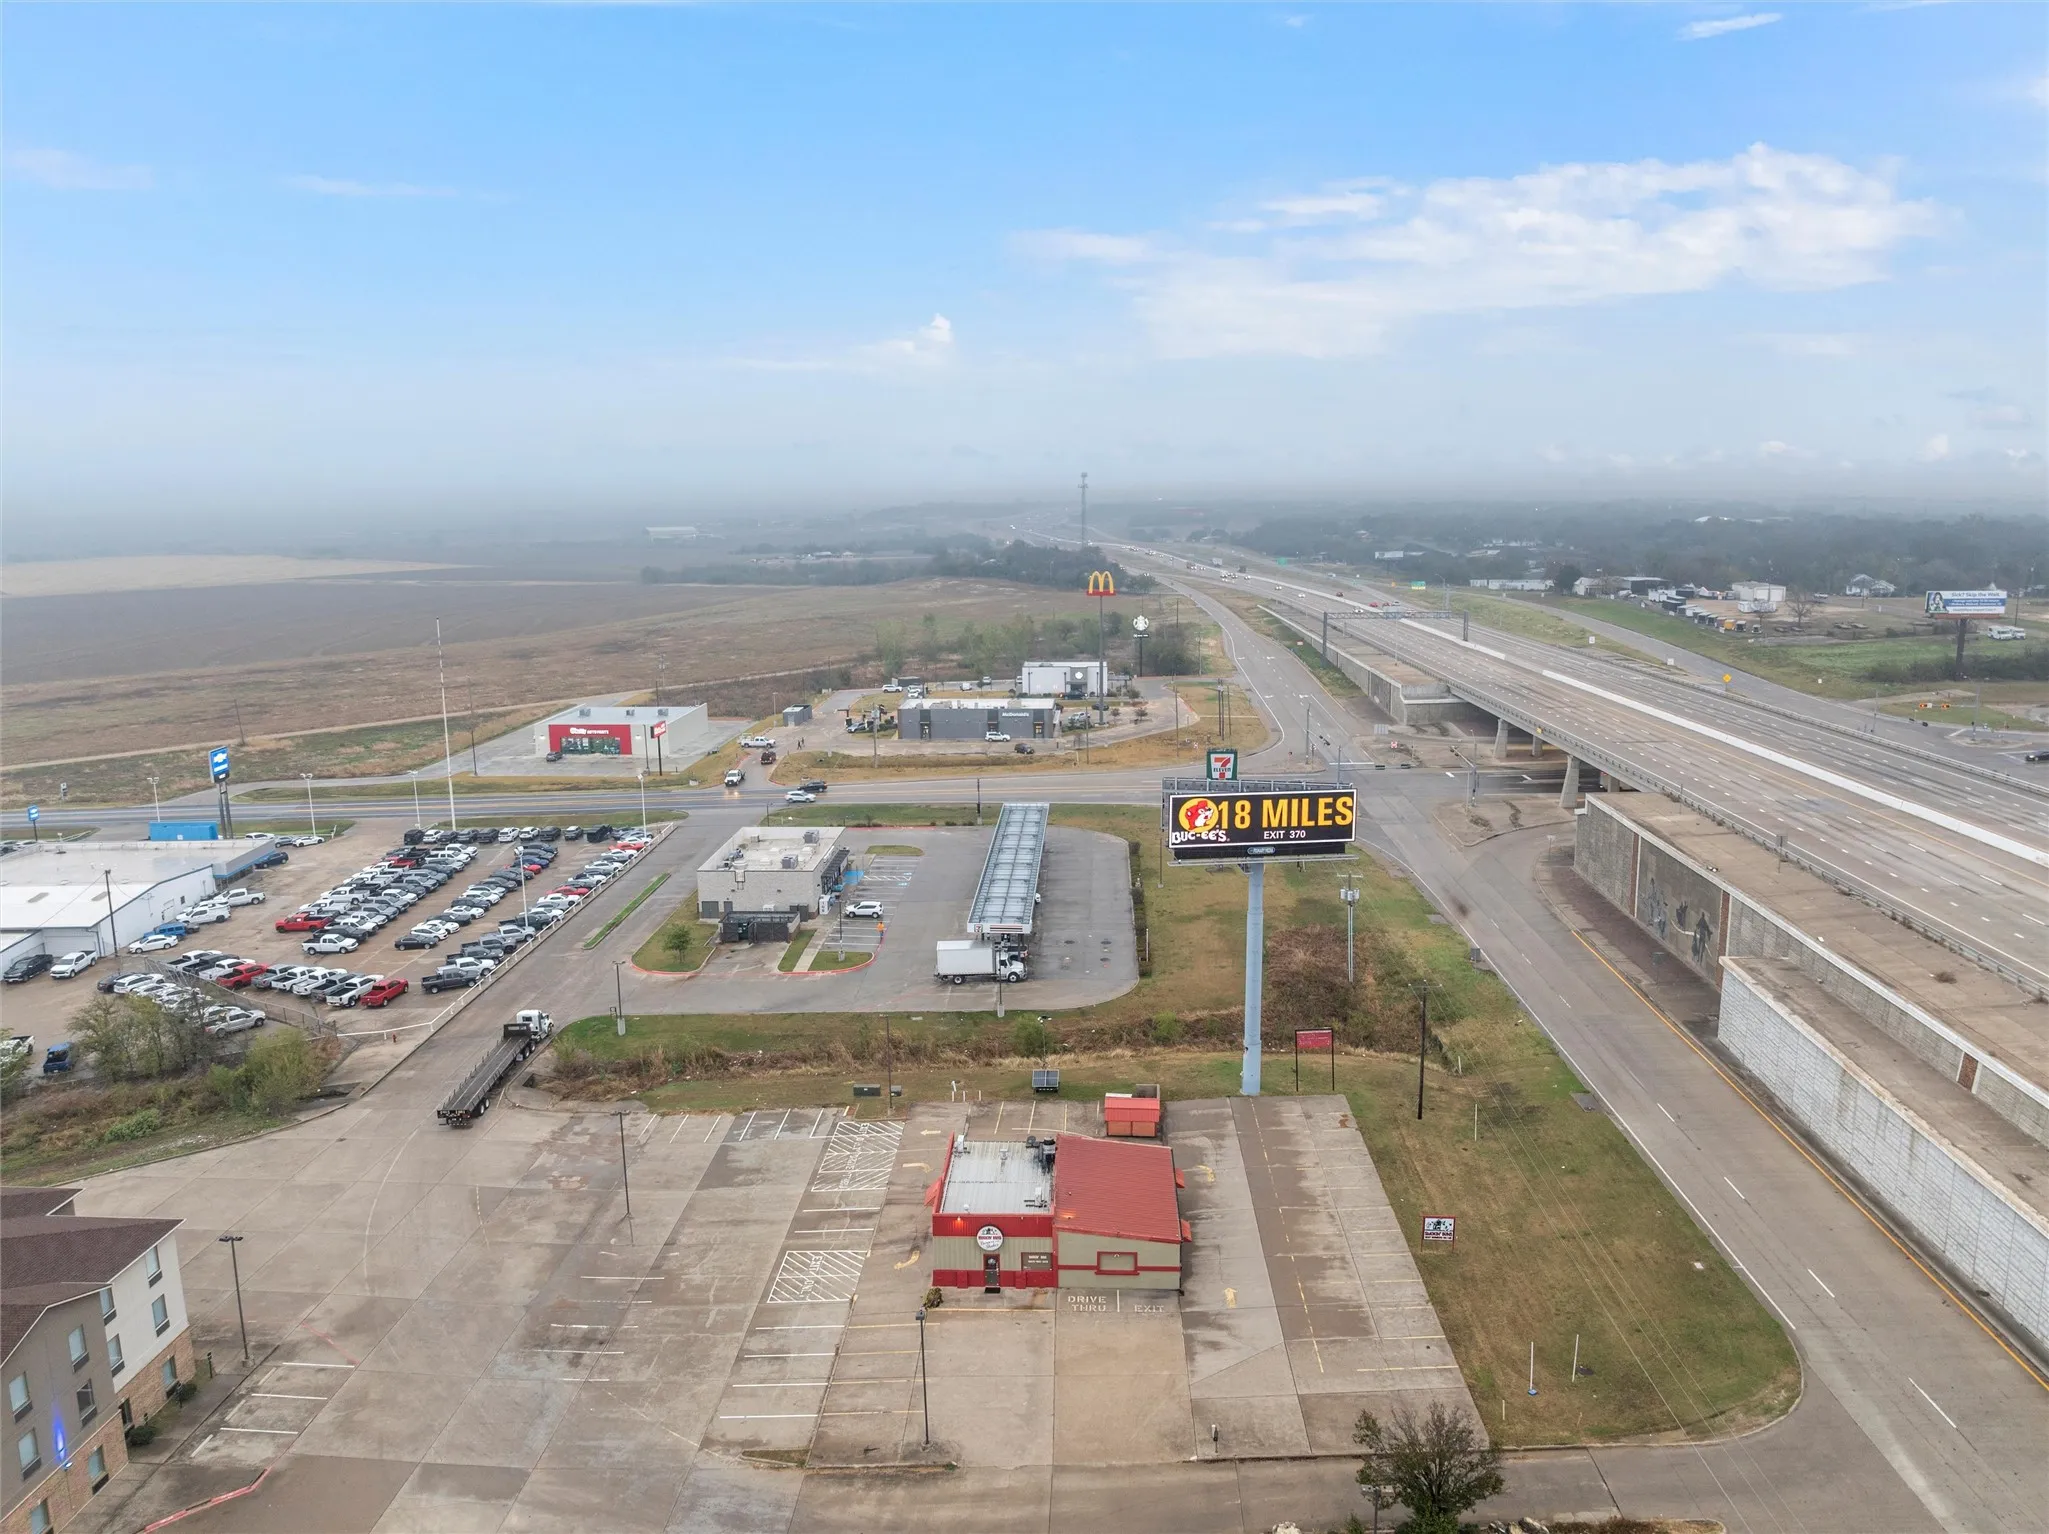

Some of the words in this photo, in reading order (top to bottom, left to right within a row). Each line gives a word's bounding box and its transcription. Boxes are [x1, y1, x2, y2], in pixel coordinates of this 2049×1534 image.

[1218, 800, 1251, 830] 18
[1262, 797, 1353, 828] MILES
[1263, 831, 1285, 840] EXIT
[1289, 830, 1306, 839] 370
[1067, 1295, 1107, 1304] DRIVE
[1072, 1304, 1106, 1312] THRU
[1134, 1304, 1165, 1313] EXIT
